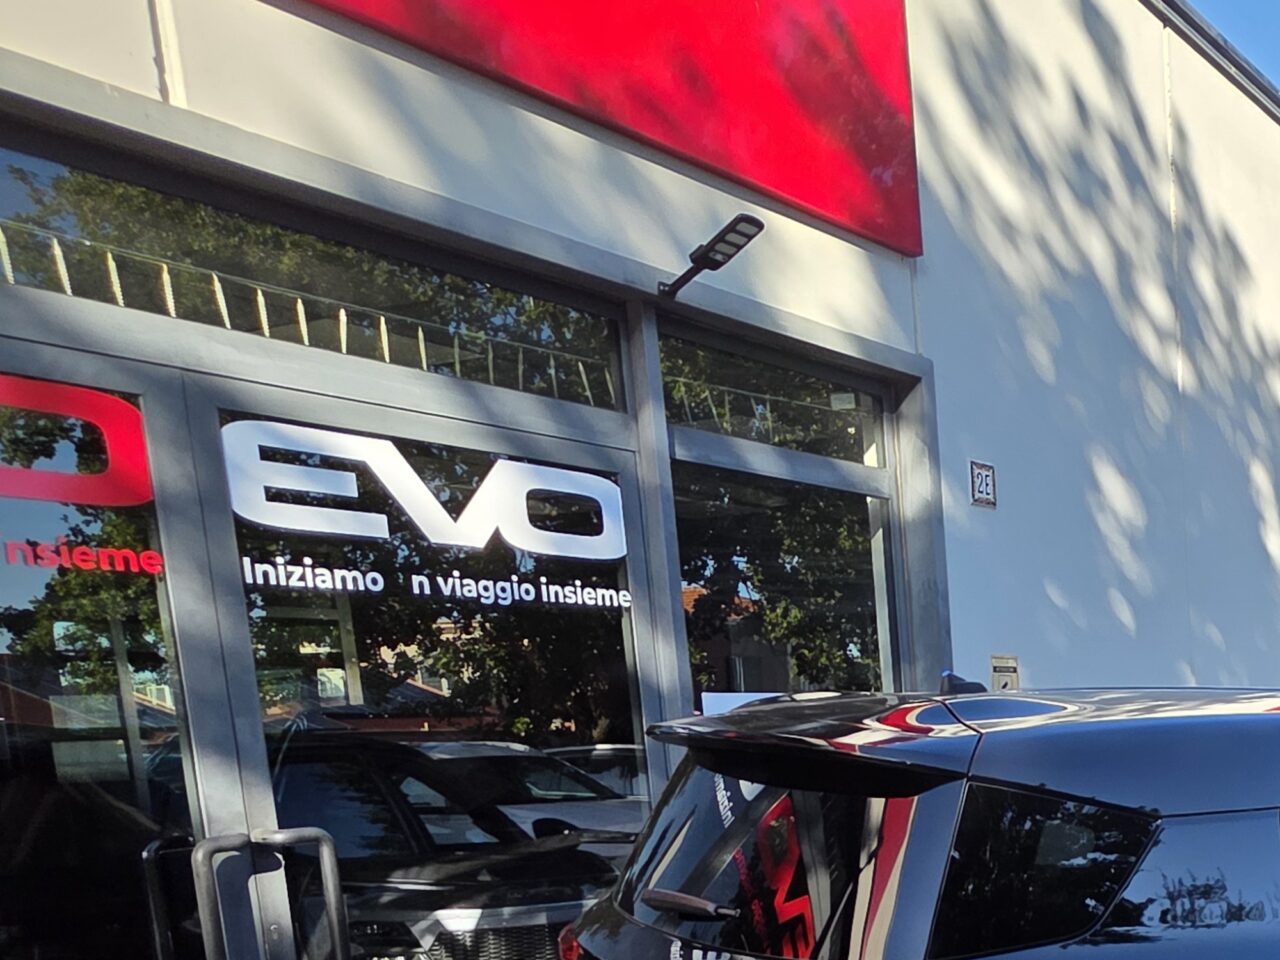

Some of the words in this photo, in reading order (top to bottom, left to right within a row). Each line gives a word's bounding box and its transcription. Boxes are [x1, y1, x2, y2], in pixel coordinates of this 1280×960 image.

[221, 419, 627, 560] EVO
[976, 471, 991, 496] 2E
[3, 534, 164, 575] nsieme
[242, 556, 385, 592] Iniziamo
[436, 570, 536, 605] viaggio
[539, 576, 633, 609] insieme
